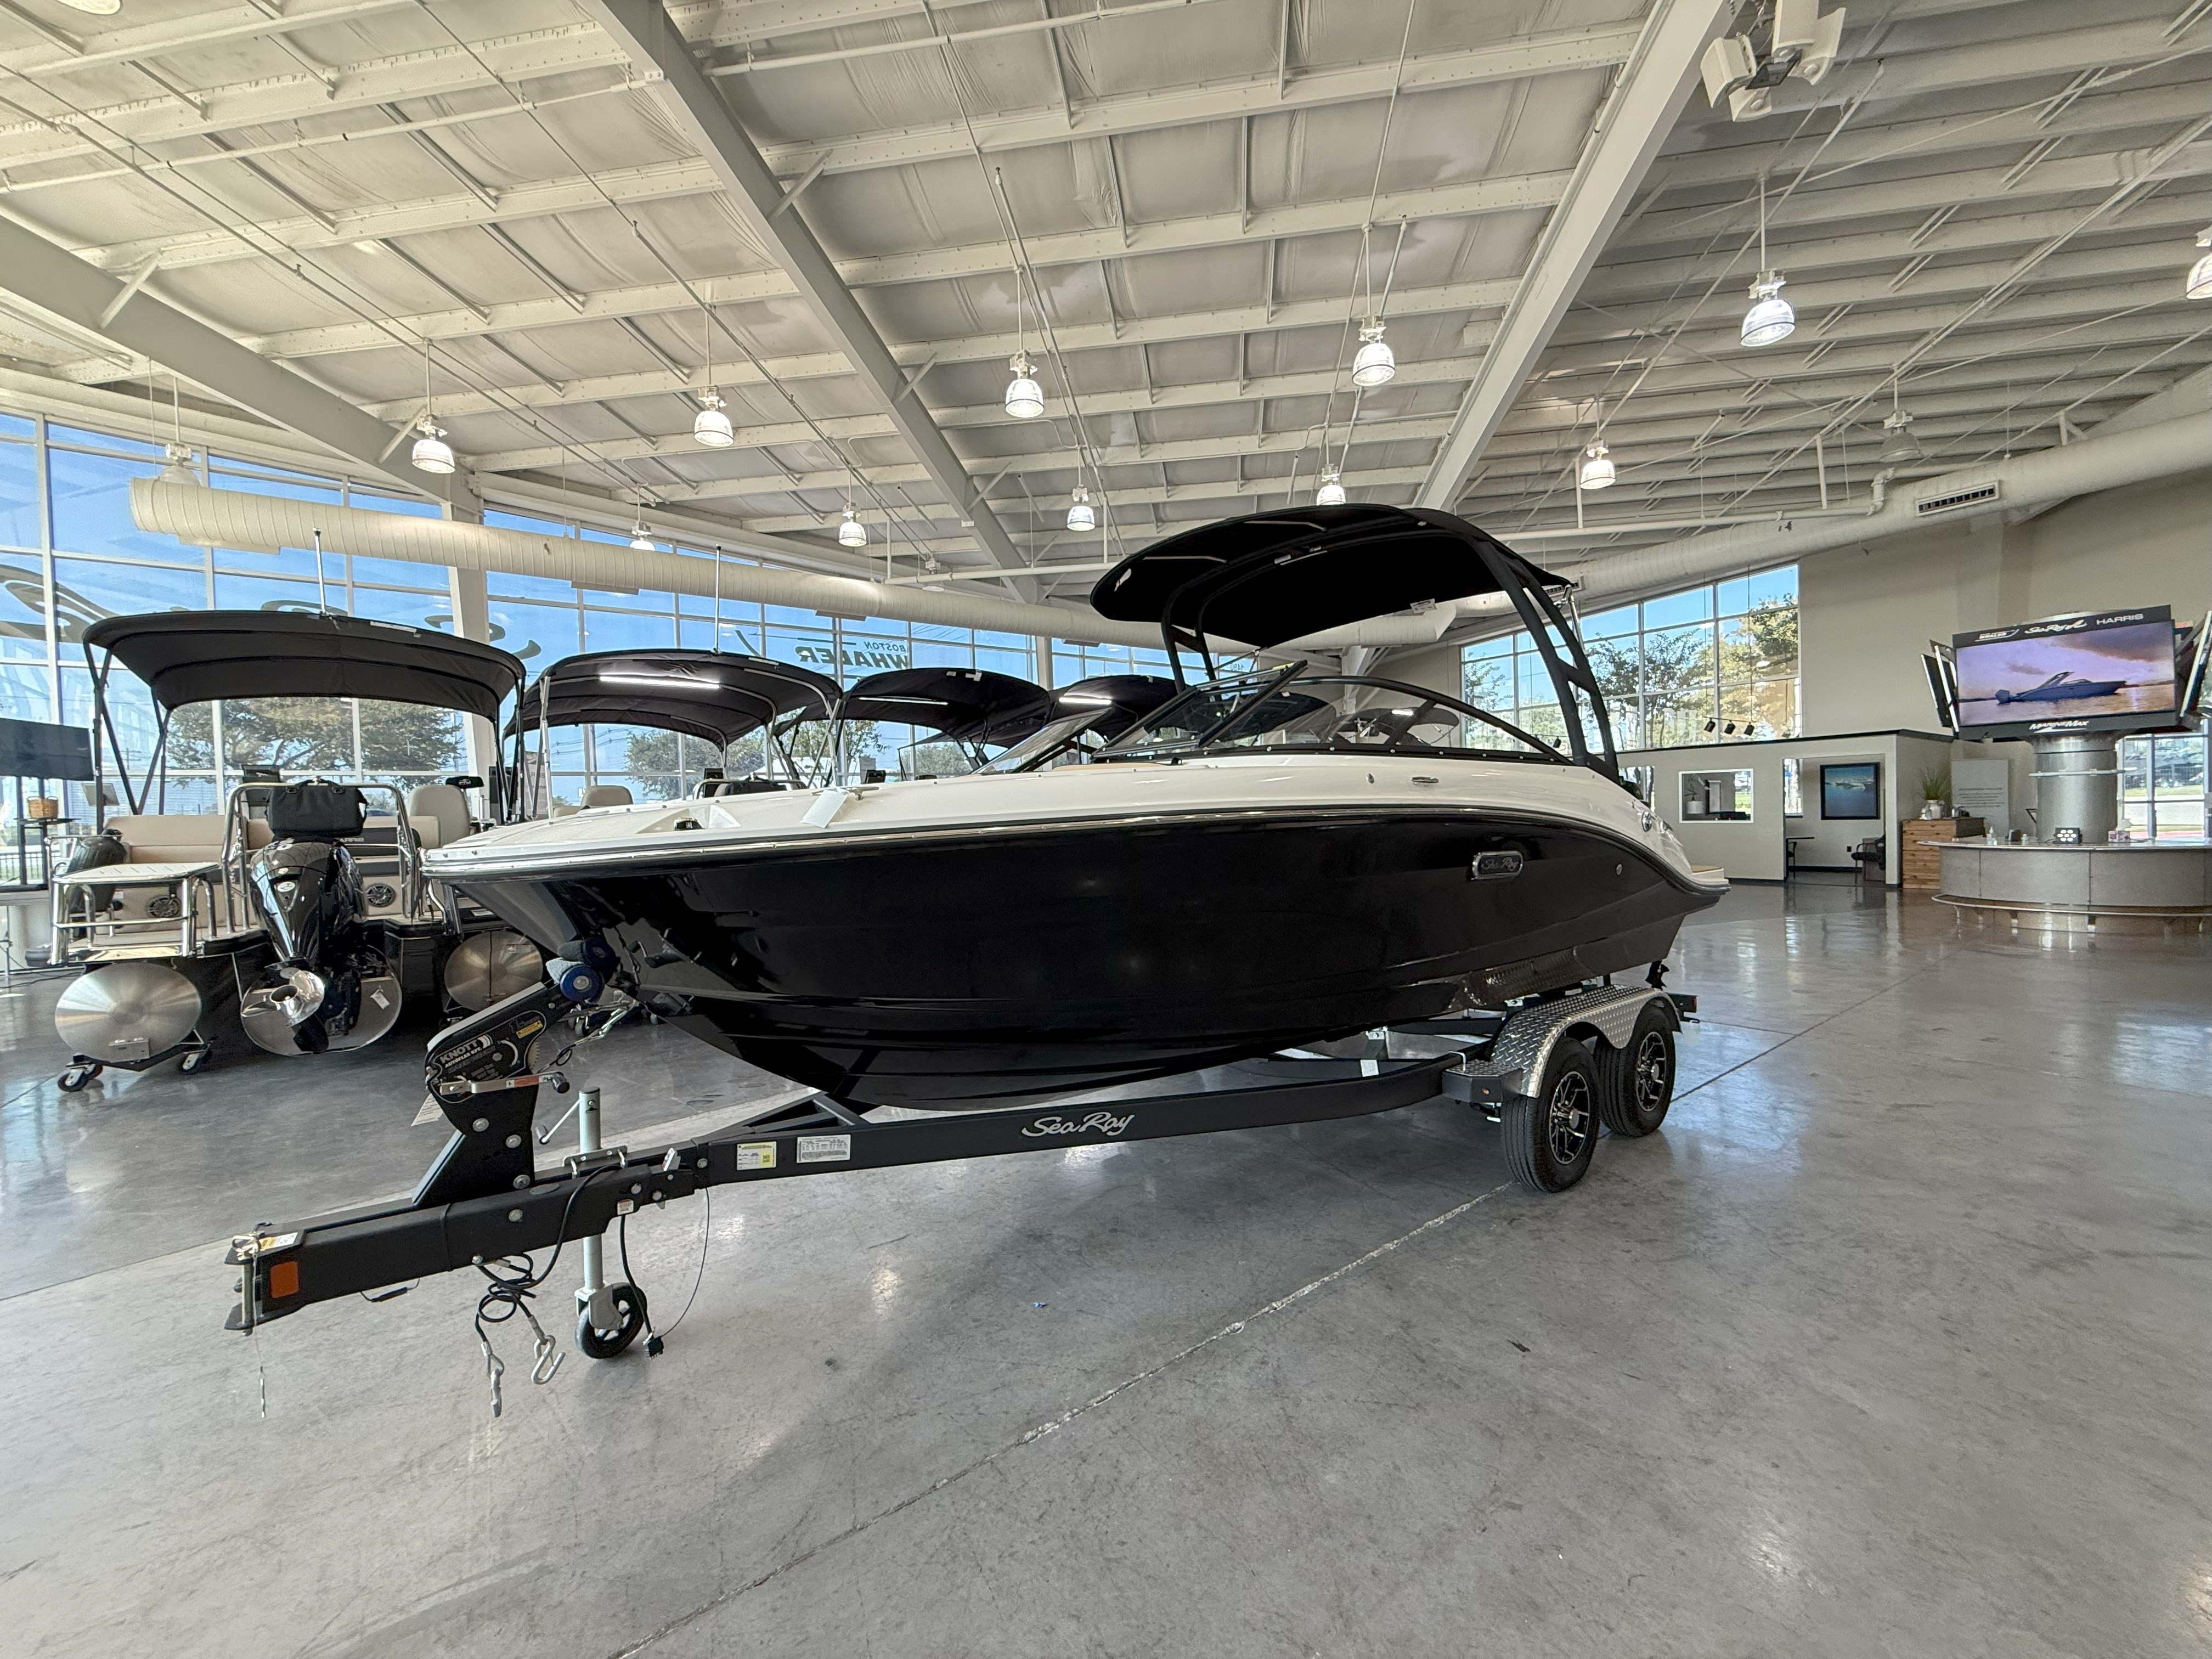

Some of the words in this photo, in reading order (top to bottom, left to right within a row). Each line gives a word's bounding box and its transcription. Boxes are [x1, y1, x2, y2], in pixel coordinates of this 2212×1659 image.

[2096, 613, 2143, 625] HARRIS
[439, 1039, 479, 1064] KNOTT
[1021, 1116, 1081, 1137] Sea
[1078, 1111, 1135, 1136] Ray
